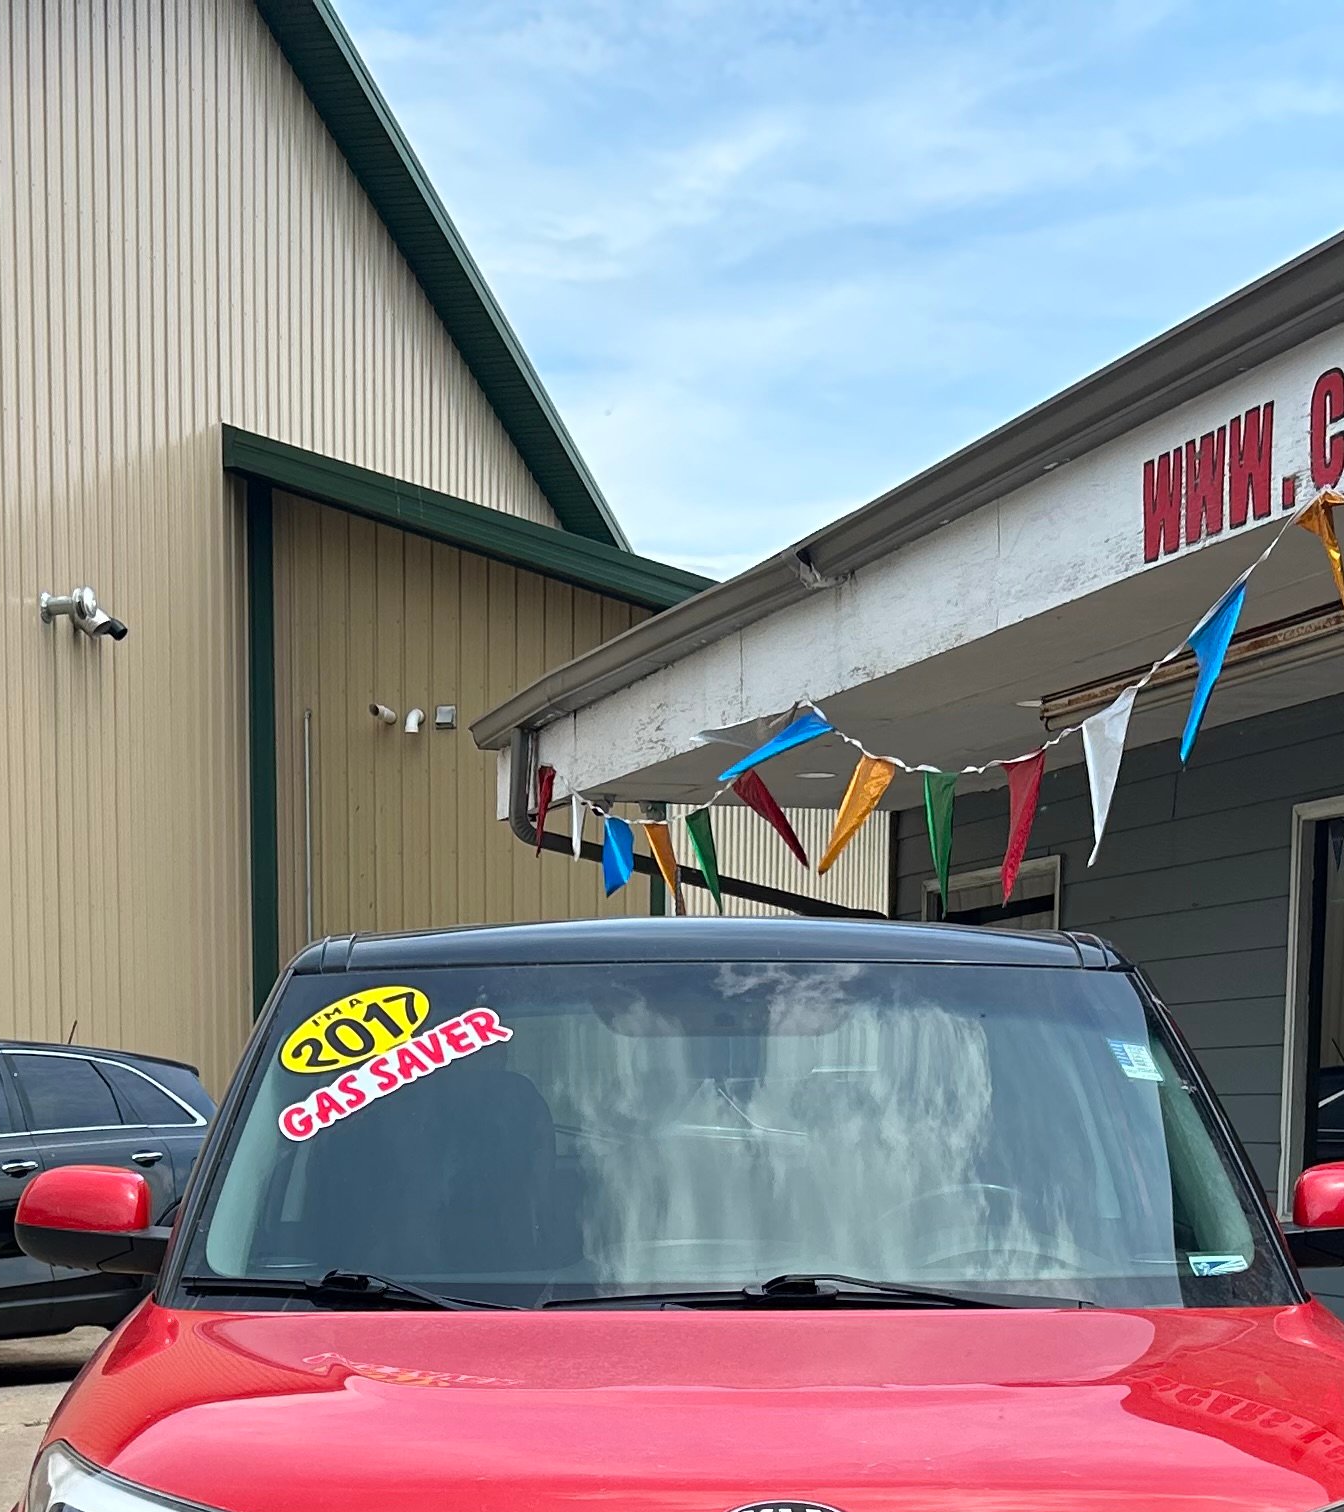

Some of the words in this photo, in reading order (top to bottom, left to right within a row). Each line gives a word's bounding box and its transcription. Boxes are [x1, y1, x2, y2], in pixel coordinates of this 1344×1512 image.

[291, 991, 418, 1067] 2017
[312, 1007, 343, 1027] I'M
[349, 998, 363, 1009] A
[283, 1075, 366, 1137] GAS
[369, 1011, 509, 1091] SAVER
